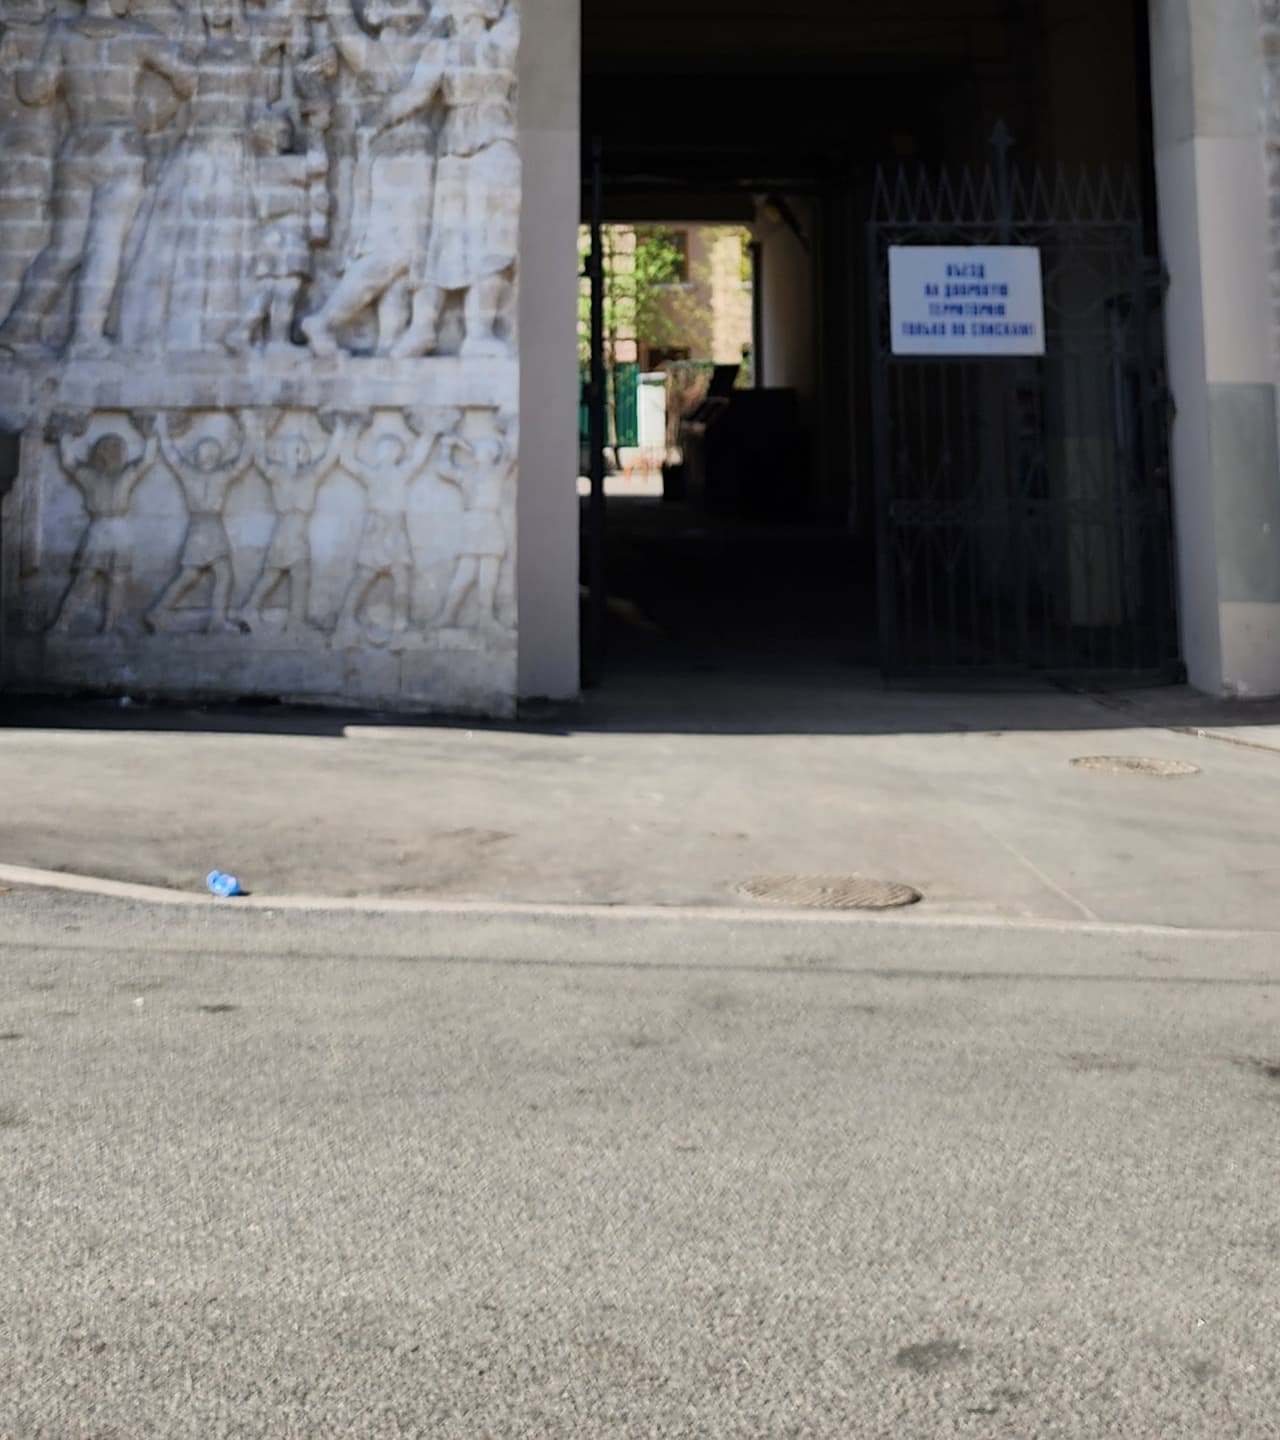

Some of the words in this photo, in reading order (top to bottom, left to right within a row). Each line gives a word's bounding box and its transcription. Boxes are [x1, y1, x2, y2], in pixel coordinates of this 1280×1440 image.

[924, 283, 939, 296] НА
[929, 302, 1006, 316] ТЕРРИТОРИЮ
[902, 322, 946, 336] ТОЛЬКО
[952, 322, 966, 335] ПО
